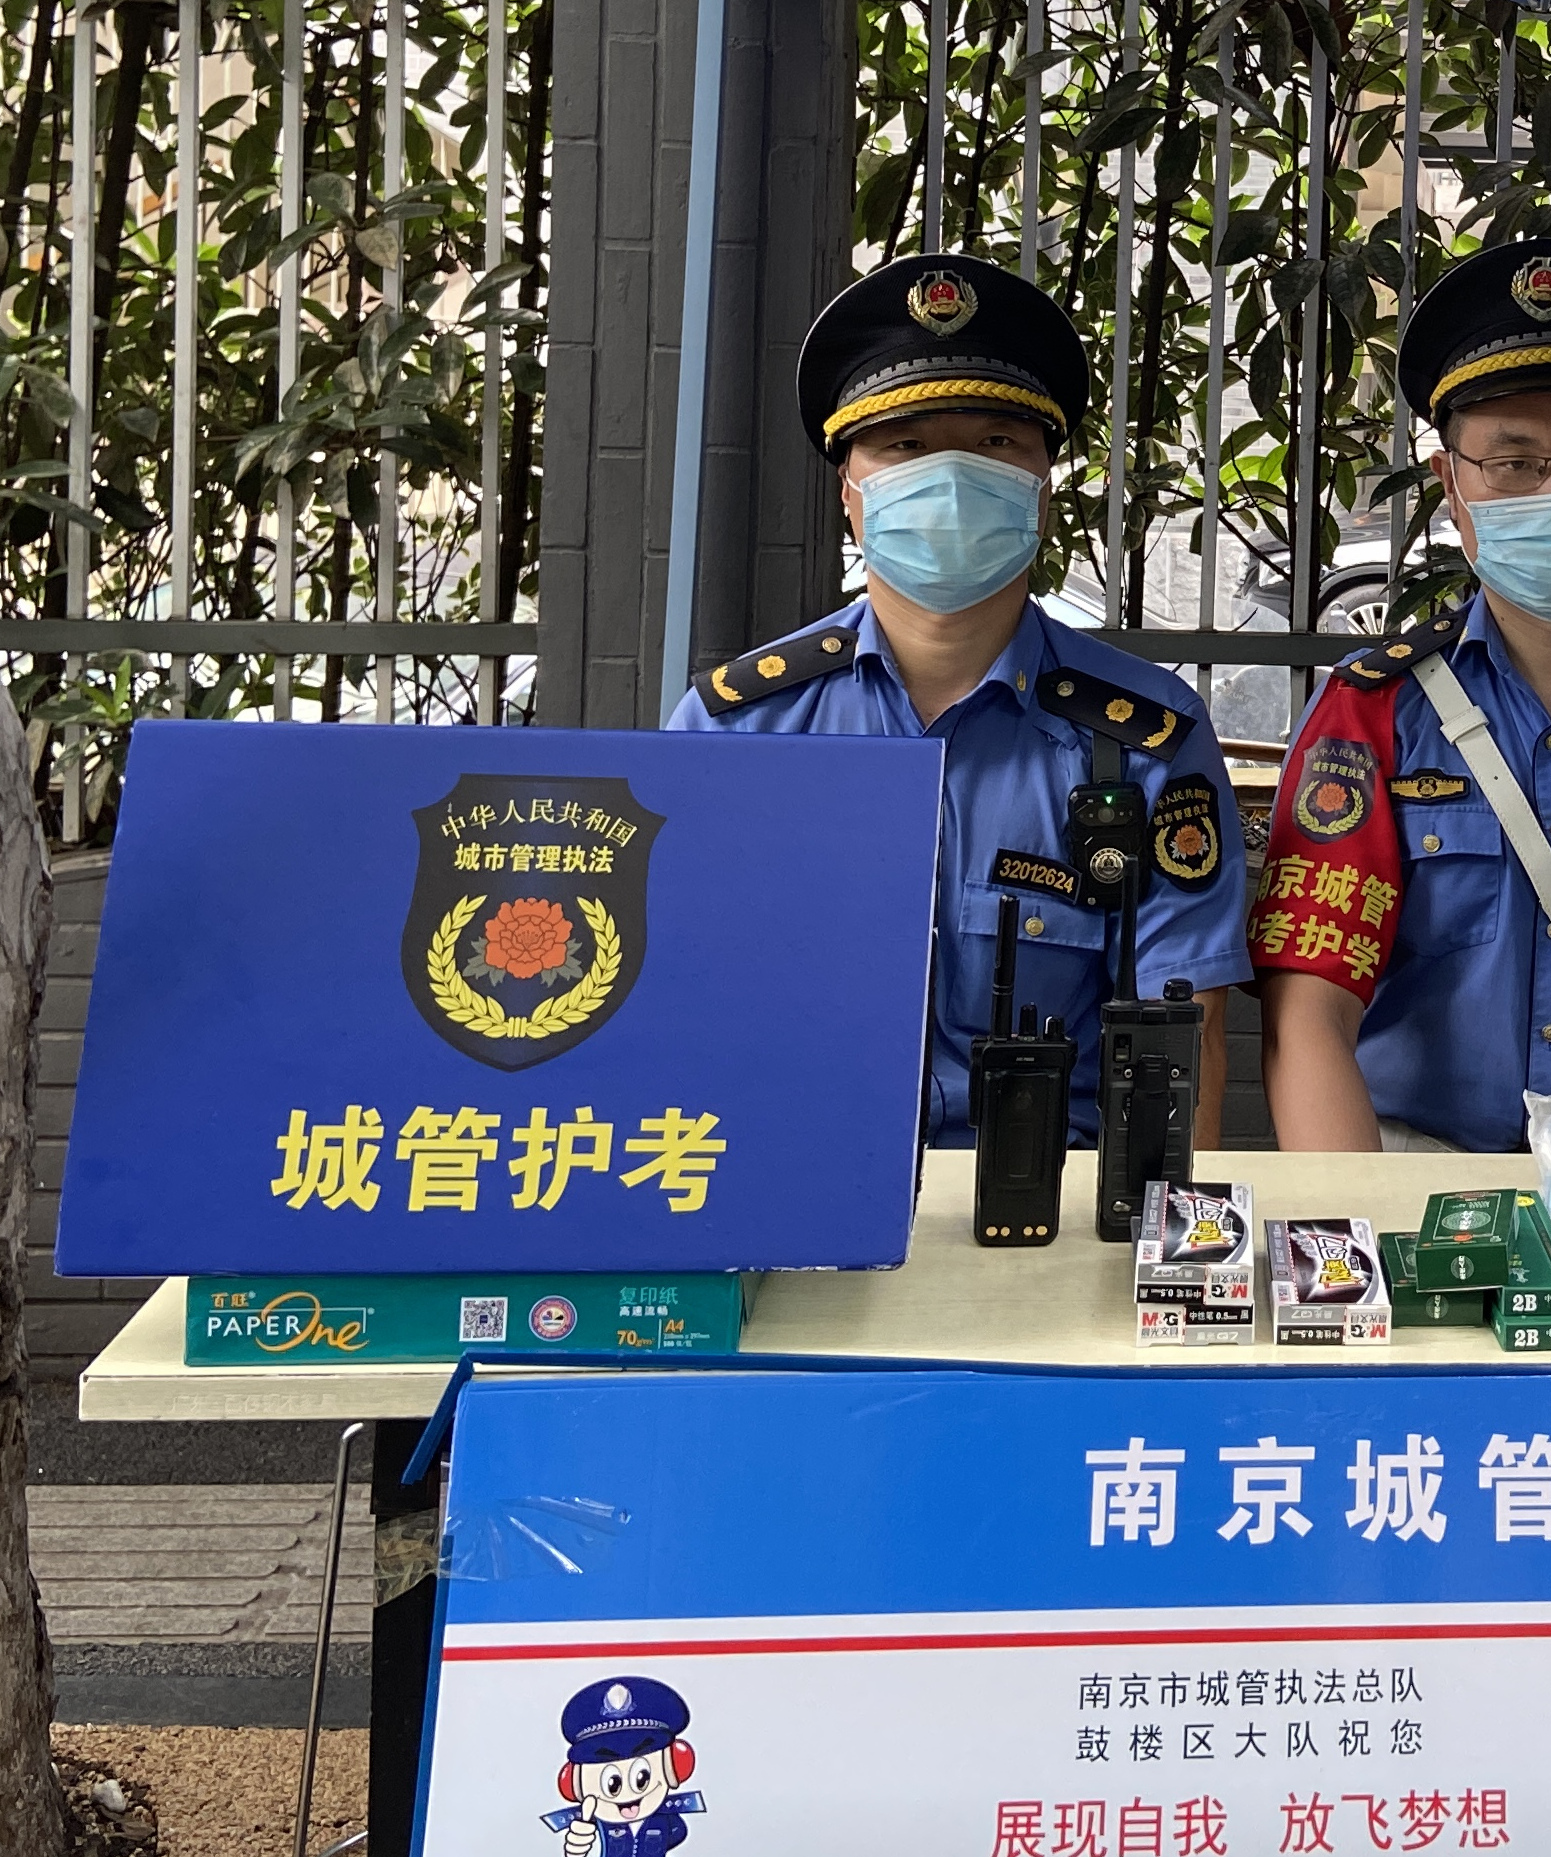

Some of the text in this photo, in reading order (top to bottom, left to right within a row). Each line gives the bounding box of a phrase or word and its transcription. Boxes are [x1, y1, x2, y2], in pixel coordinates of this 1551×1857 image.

[440, 797, 638, 848] 中华人民共和国
[454, 842, 614, 876] 城市管理执法
[999, 858, 1075, 894] 32012624
[1249, 909, 1381, 980] 考护学
[270, 1105, 728, 1213] 城管护考
[211, 1292, 250, 1308] 百旺
[619, 1286, 679, 1306] 复印纸
[1512, 1294, 1537, 1311] 2B
[207, 1315, 302, 1337] PAPER
[665, 1319, 685, 1333] A4
[1514, 1329, 1539, 1347] 2B
[1078, 1667, 1423, 1709] 南京市城管执法总队
[1075, 1719, 1423, 1763] 鼓楼区大队祝您
[992, 1788, 1511, 1857] 展现自我 放飞梦想
